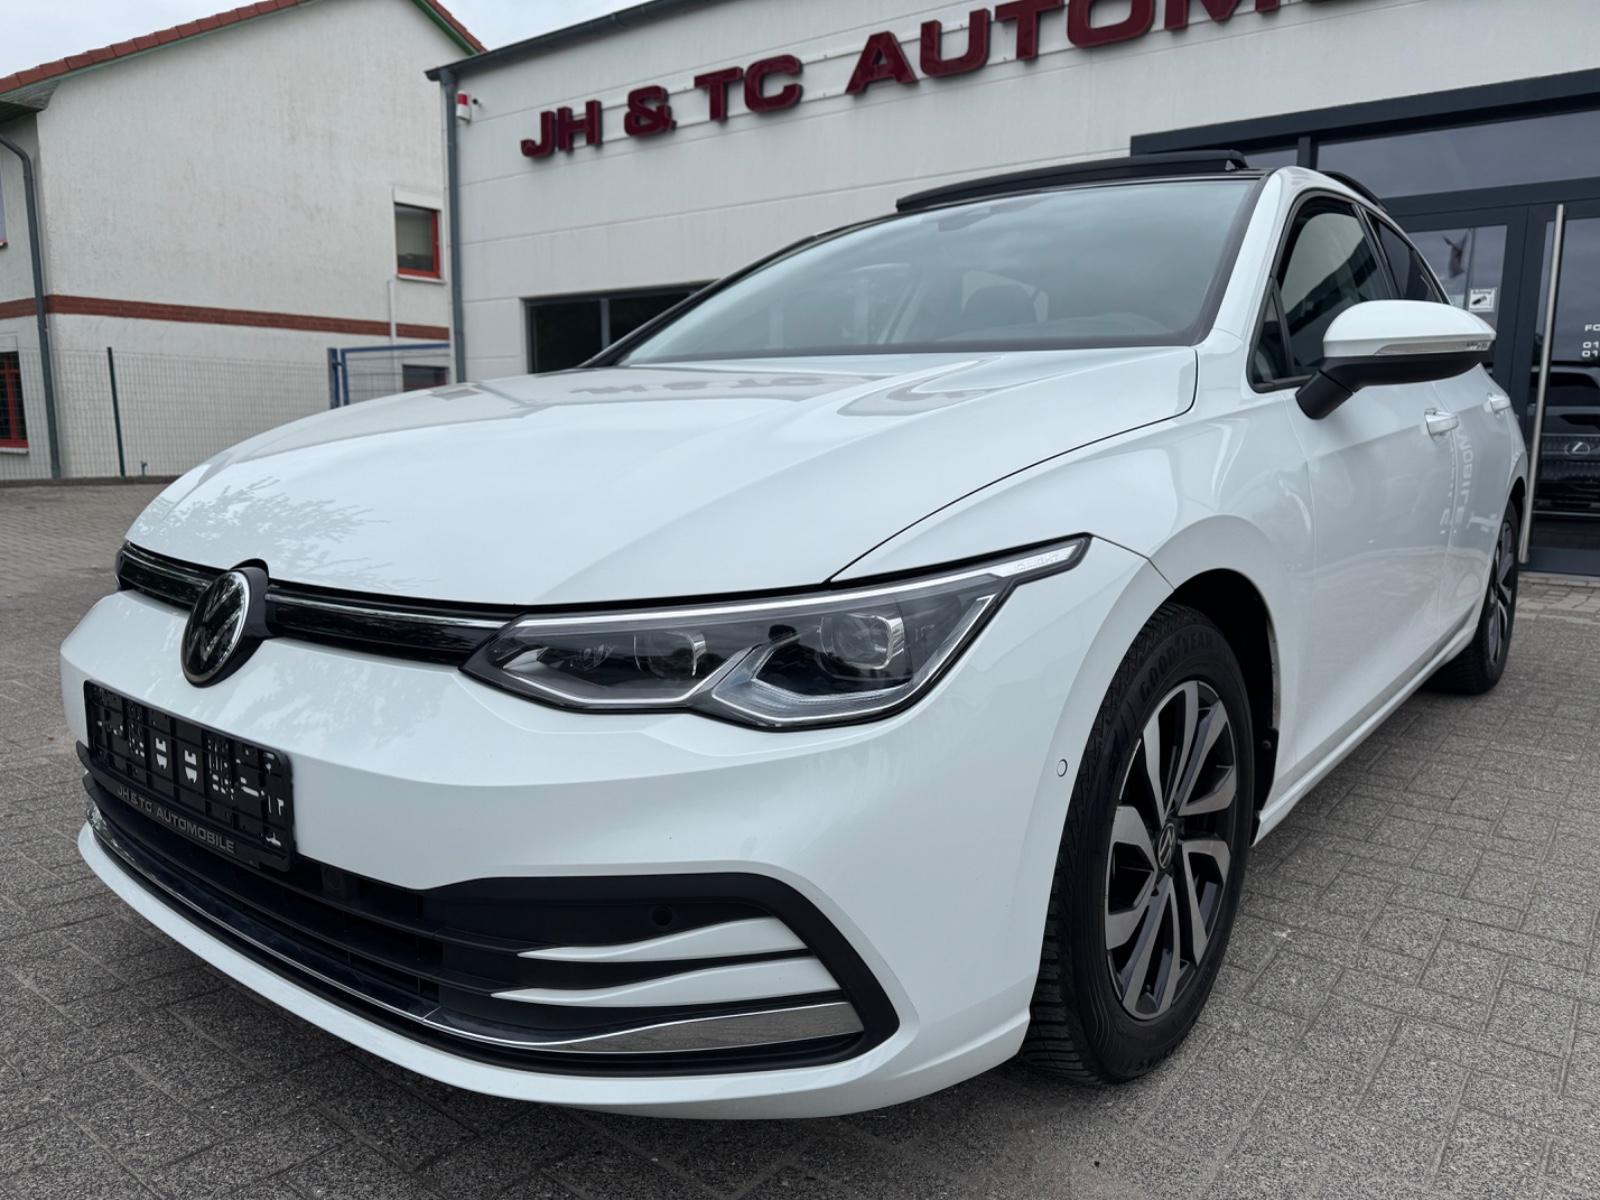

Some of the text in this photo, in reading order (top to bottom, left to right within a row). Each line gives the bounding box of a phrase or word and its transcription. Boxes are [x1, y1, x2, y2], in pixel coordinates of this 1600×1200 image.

[520, 99, 603, 158] JH
[624, 84, 677, 137] &
[694, 54, 804, 122] TC
[156, 807, 236, 855] AUTOMOBILE
